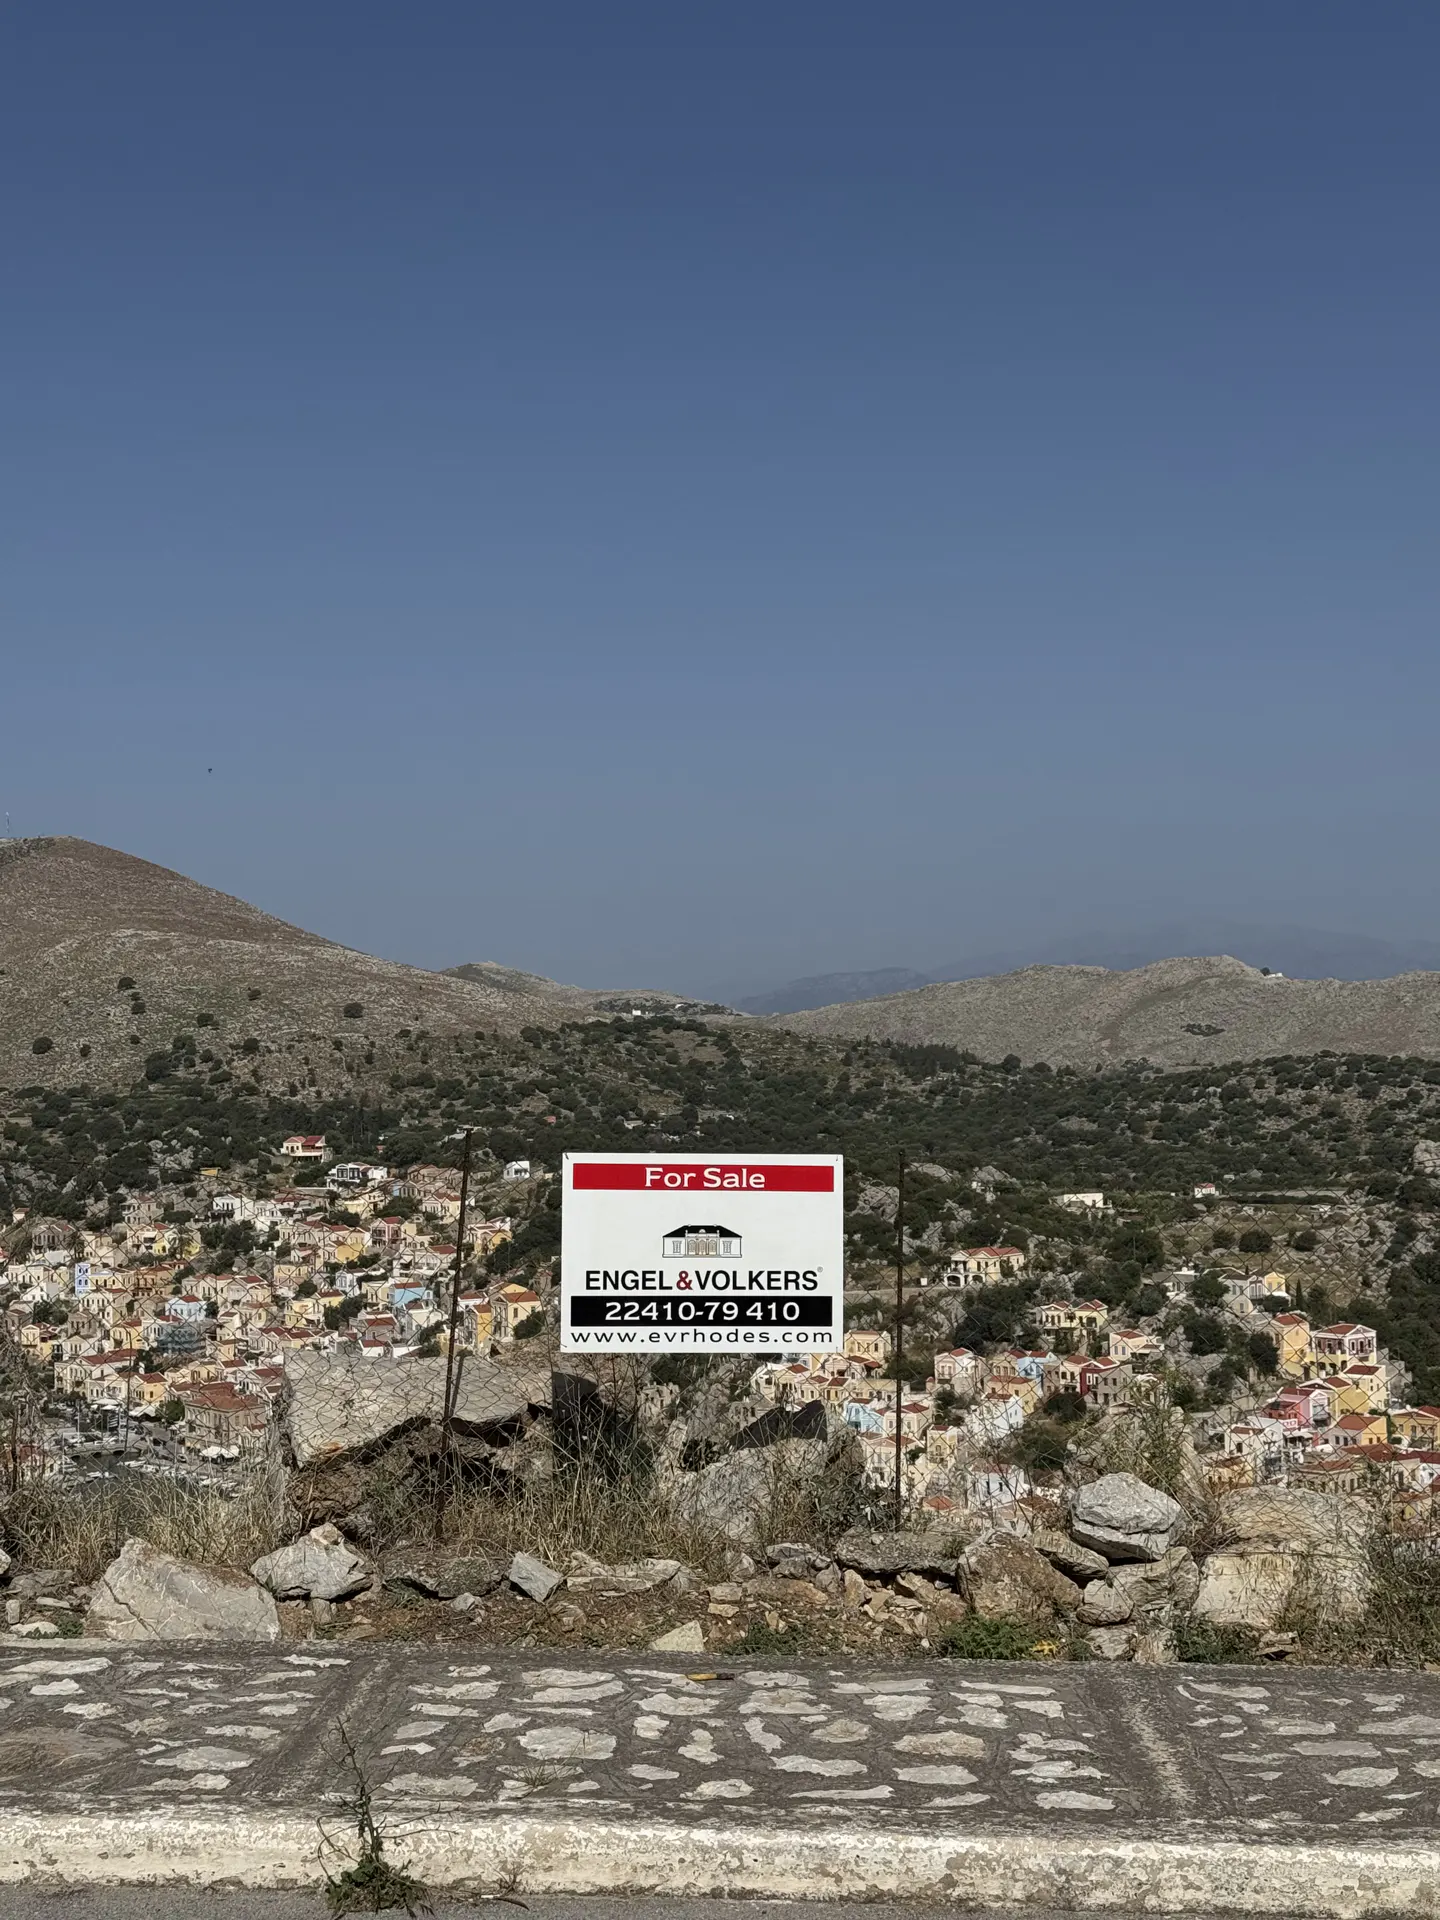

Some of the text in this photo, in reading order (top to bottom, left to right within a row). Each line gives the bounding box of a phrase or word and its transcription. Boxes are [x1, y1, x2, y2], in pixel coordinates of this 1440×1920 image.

[644, 1166, 766, 1189] For Sale
[605, 1301, 800, 1321] 22410-79 410
[570, 1328, 833, 1343] www.evrhodes.com
